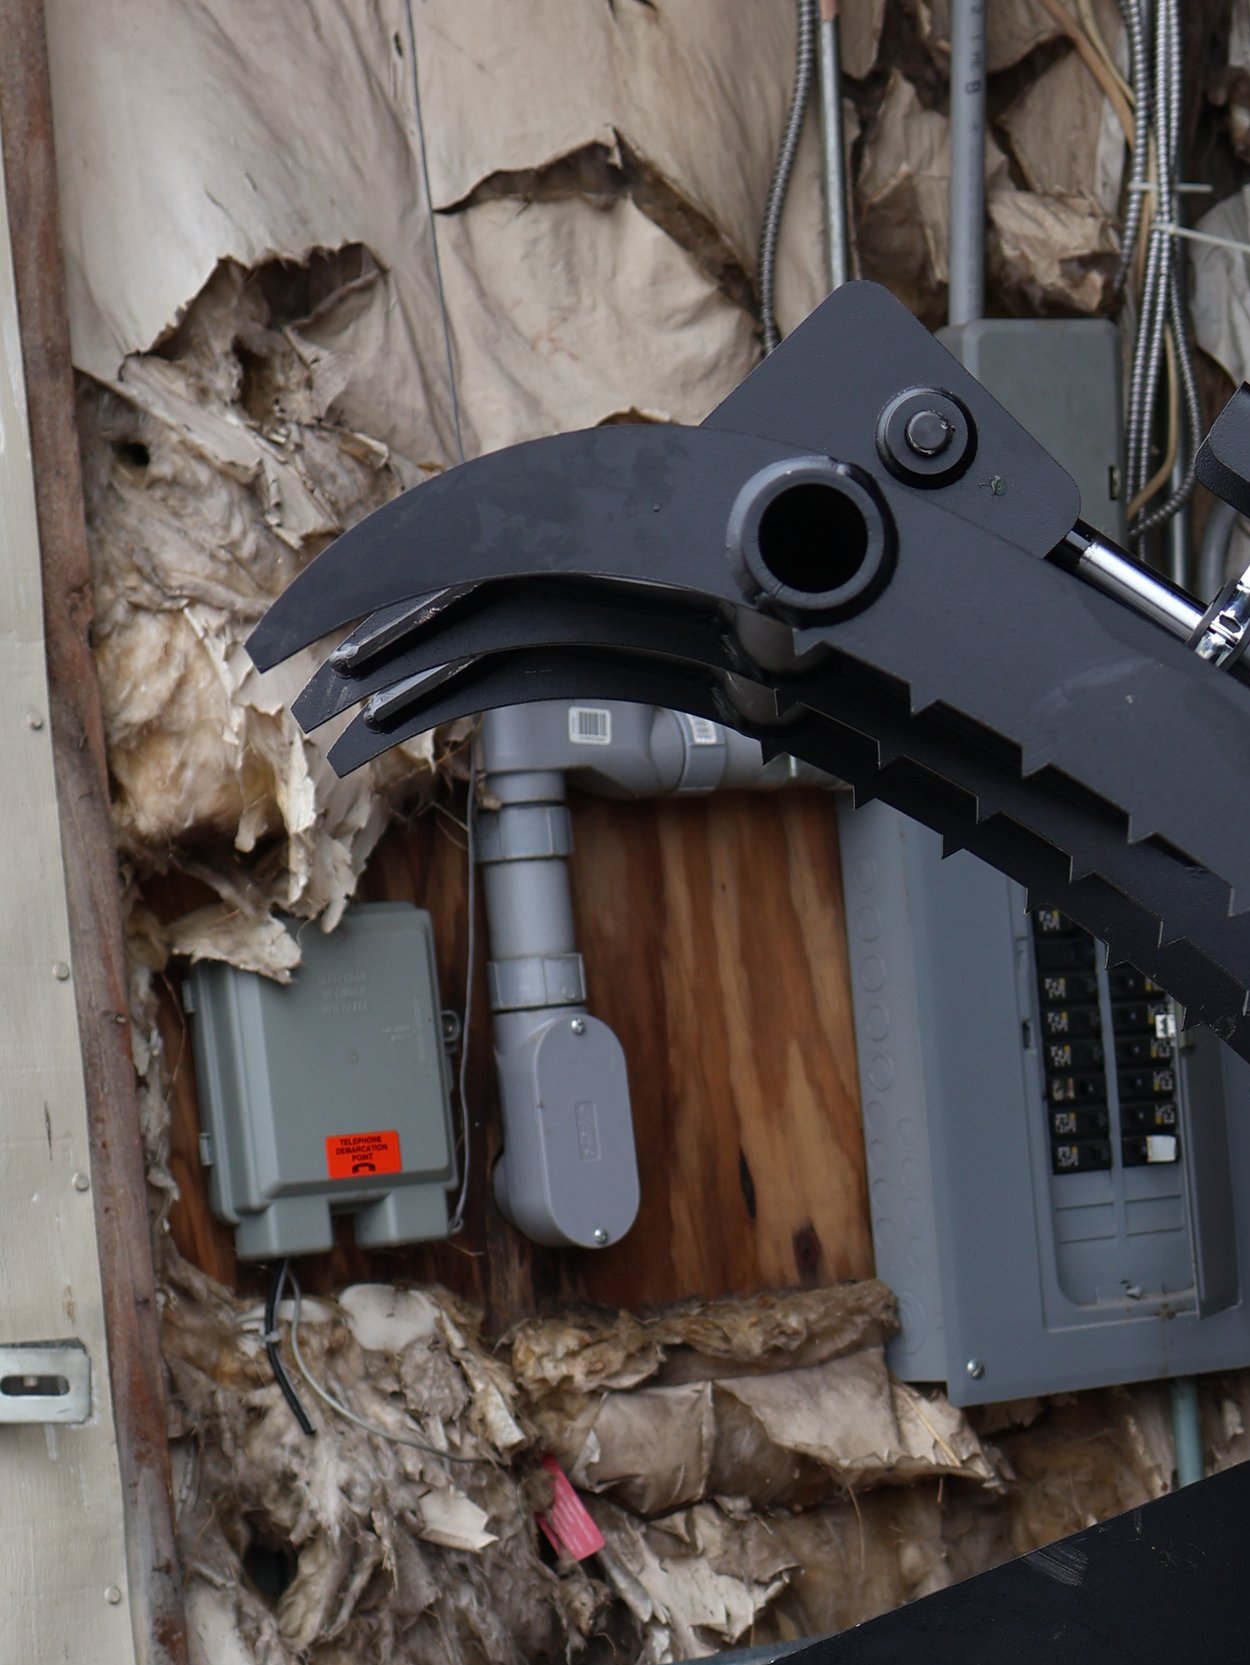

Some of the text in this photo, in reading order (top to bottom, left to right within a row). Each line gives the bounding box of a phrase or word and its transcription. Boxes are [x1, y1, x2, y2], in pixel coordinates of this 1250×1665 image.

[340, 1136, 382, 1146] TELEPHONE
[336, 1144, 388, 1155] DEMARCATION
[352, 1153, 373, 1162] POINT
